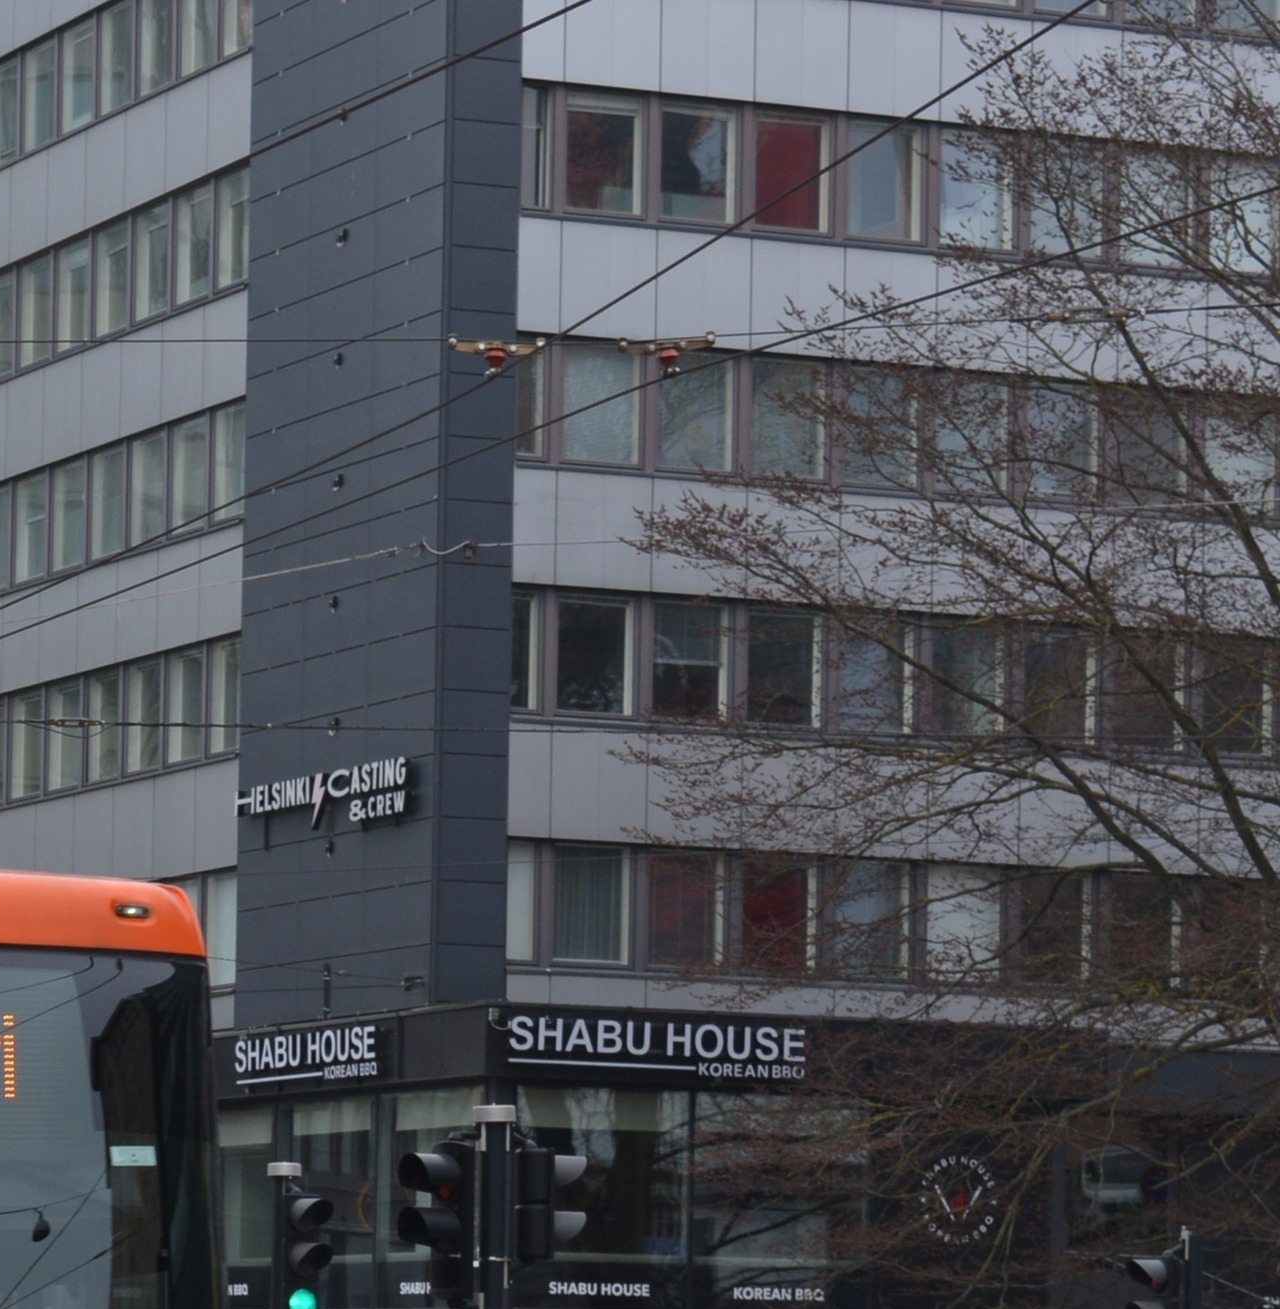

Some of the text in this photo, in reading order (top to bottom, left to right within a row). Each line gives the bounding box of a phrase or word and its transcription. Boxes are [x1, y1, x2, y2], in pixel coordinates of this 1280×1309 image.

[234, 756, 407, 817] HELSINKI CASTING
[509, 1016, 806, 1062] SHABU HOUSE
[234, 1025, 376, 1073] SHABU HOUSE
[324, 1062, 378, 1080] KOREAN BBQ
[698, 1062, 805, 1079] KOREAN BBQ
[233, 1283, 249, 1296] BBQ
[399, 1281, 425, 1295] SHABU
[548, 1281, 650, 1297] SHABU HOUSE
[733, 1286, 825, 1302] KOREAN BBQ
